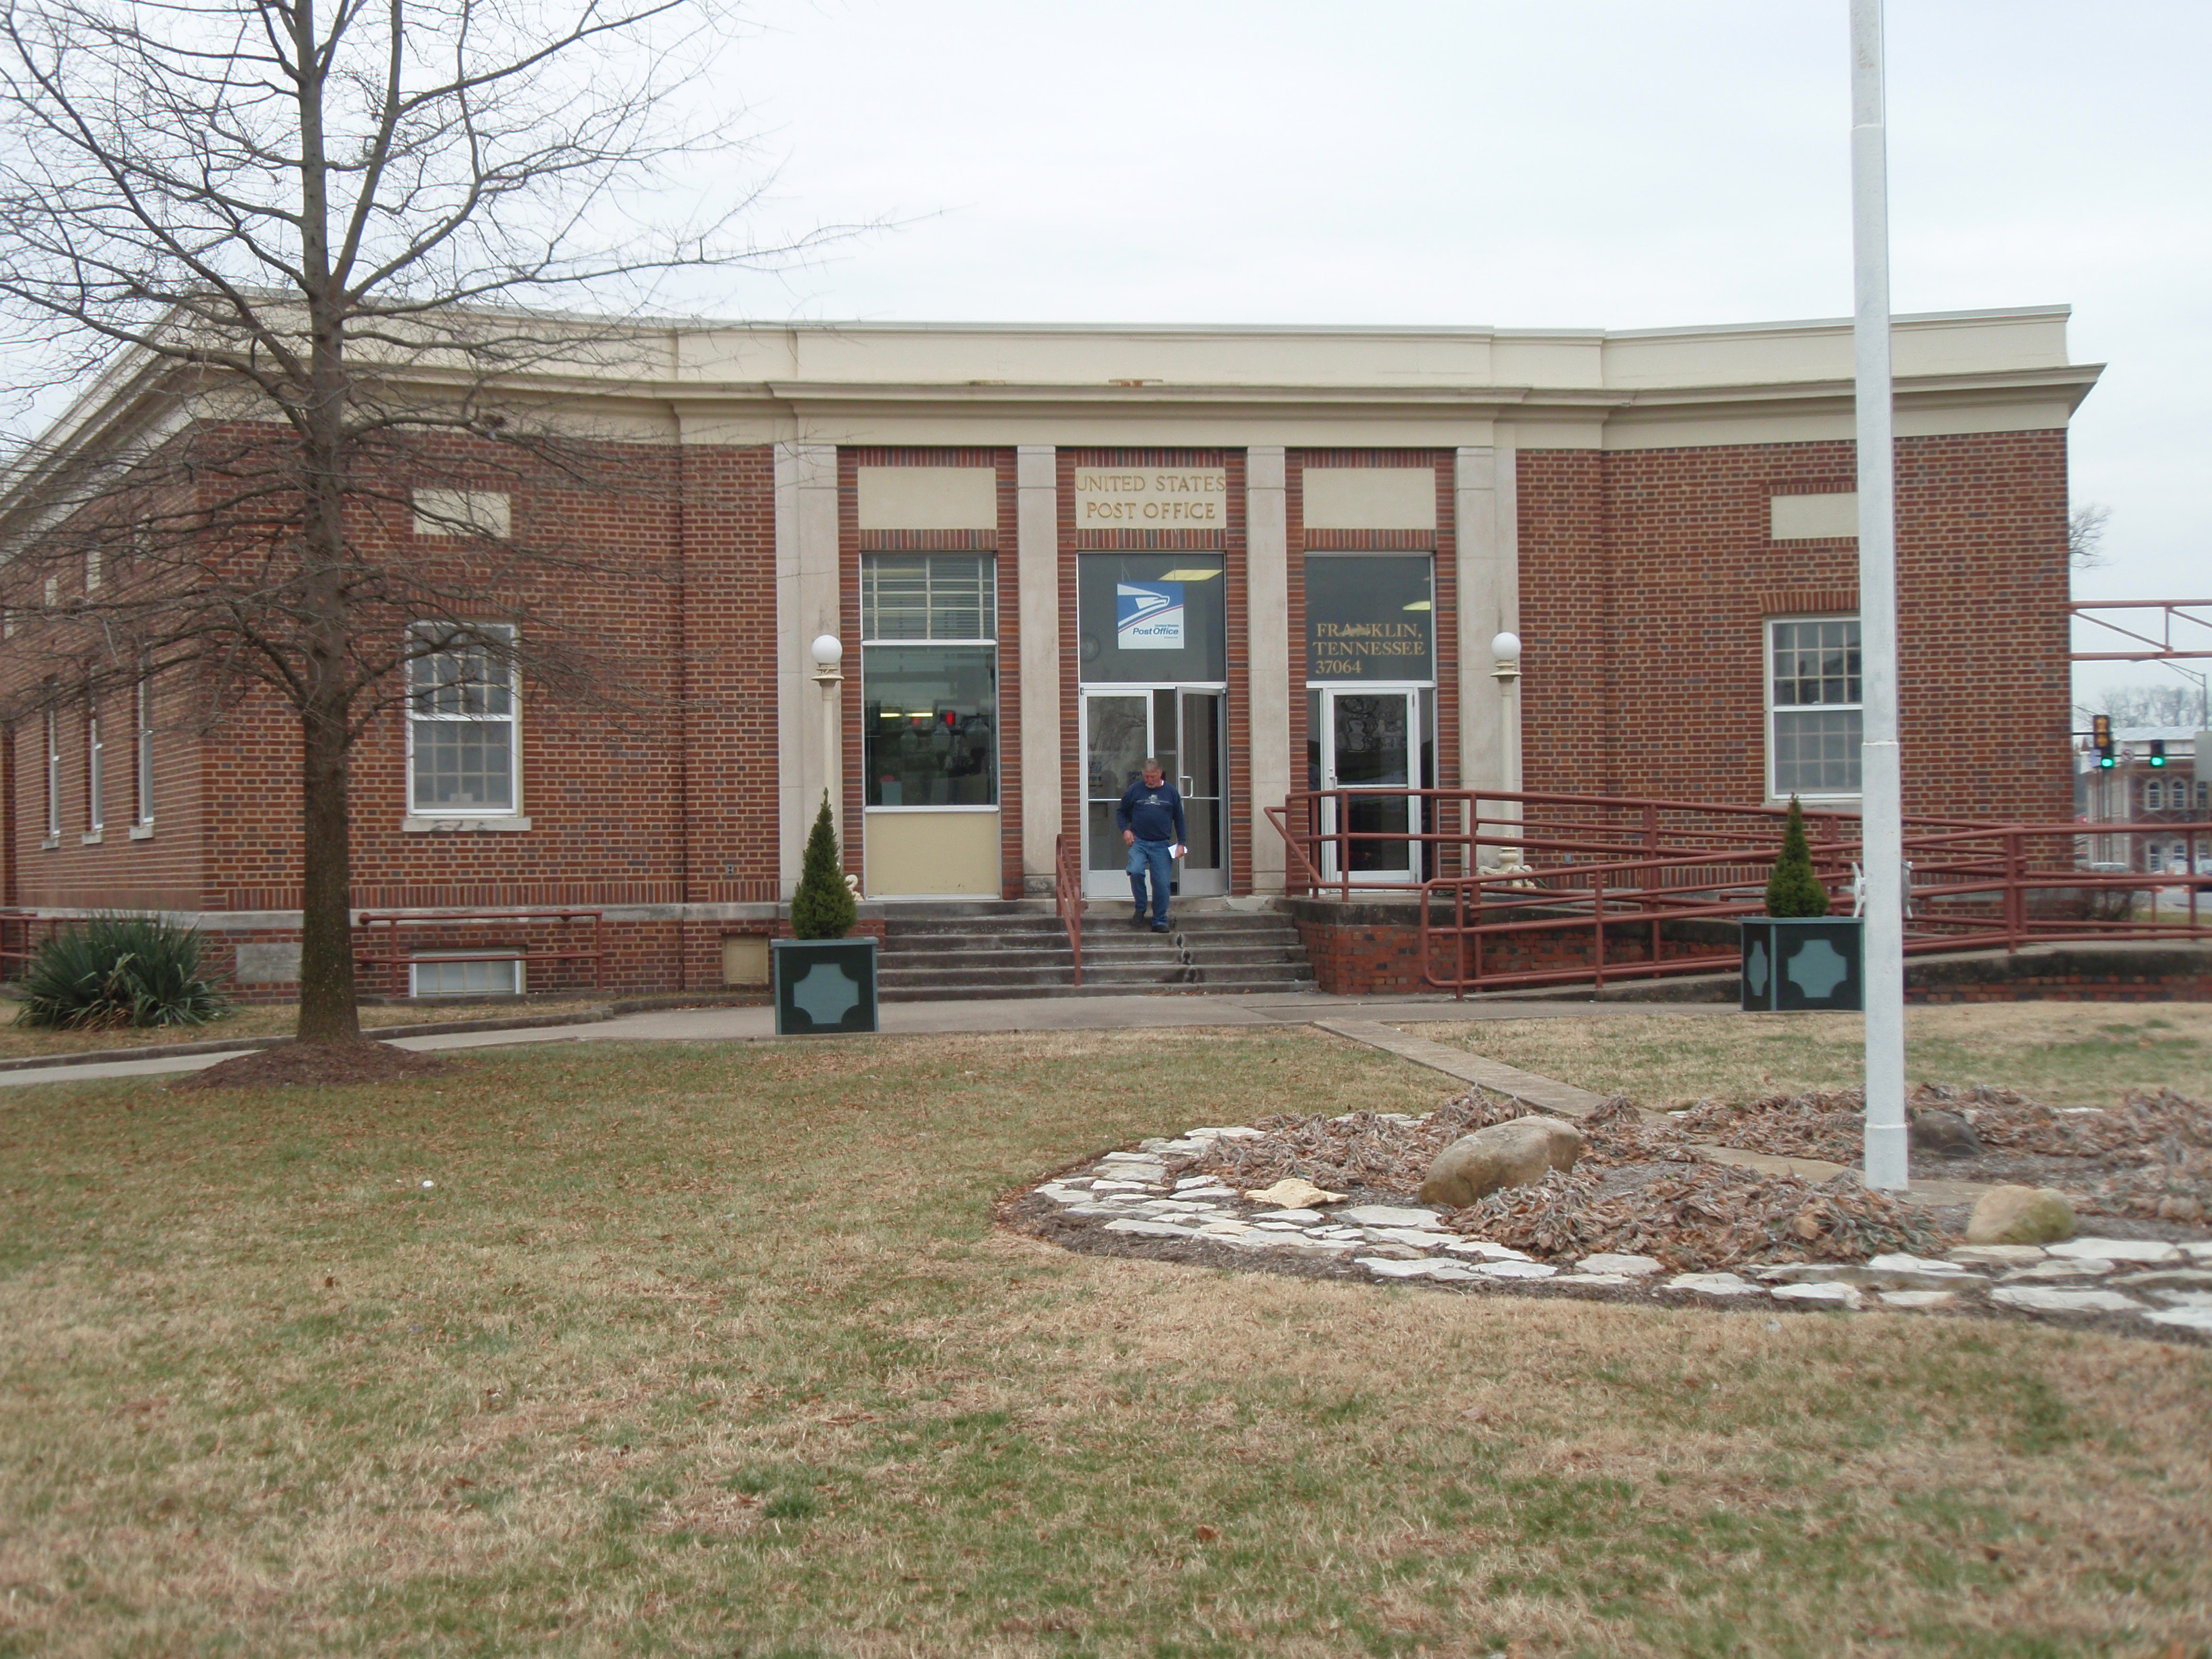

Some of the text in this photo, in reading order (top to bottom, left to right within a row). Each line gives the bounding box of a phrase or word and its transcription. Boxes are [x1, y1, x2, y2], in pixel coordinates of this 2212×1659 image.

[1076, 476, 1226, 492] UNITED STATES
[1086, 502, 1215, 519] POST OFFICE
[1313, 641, 1425, 656] TENNESSEE
[1315, 659, 1362, 674] 37064
